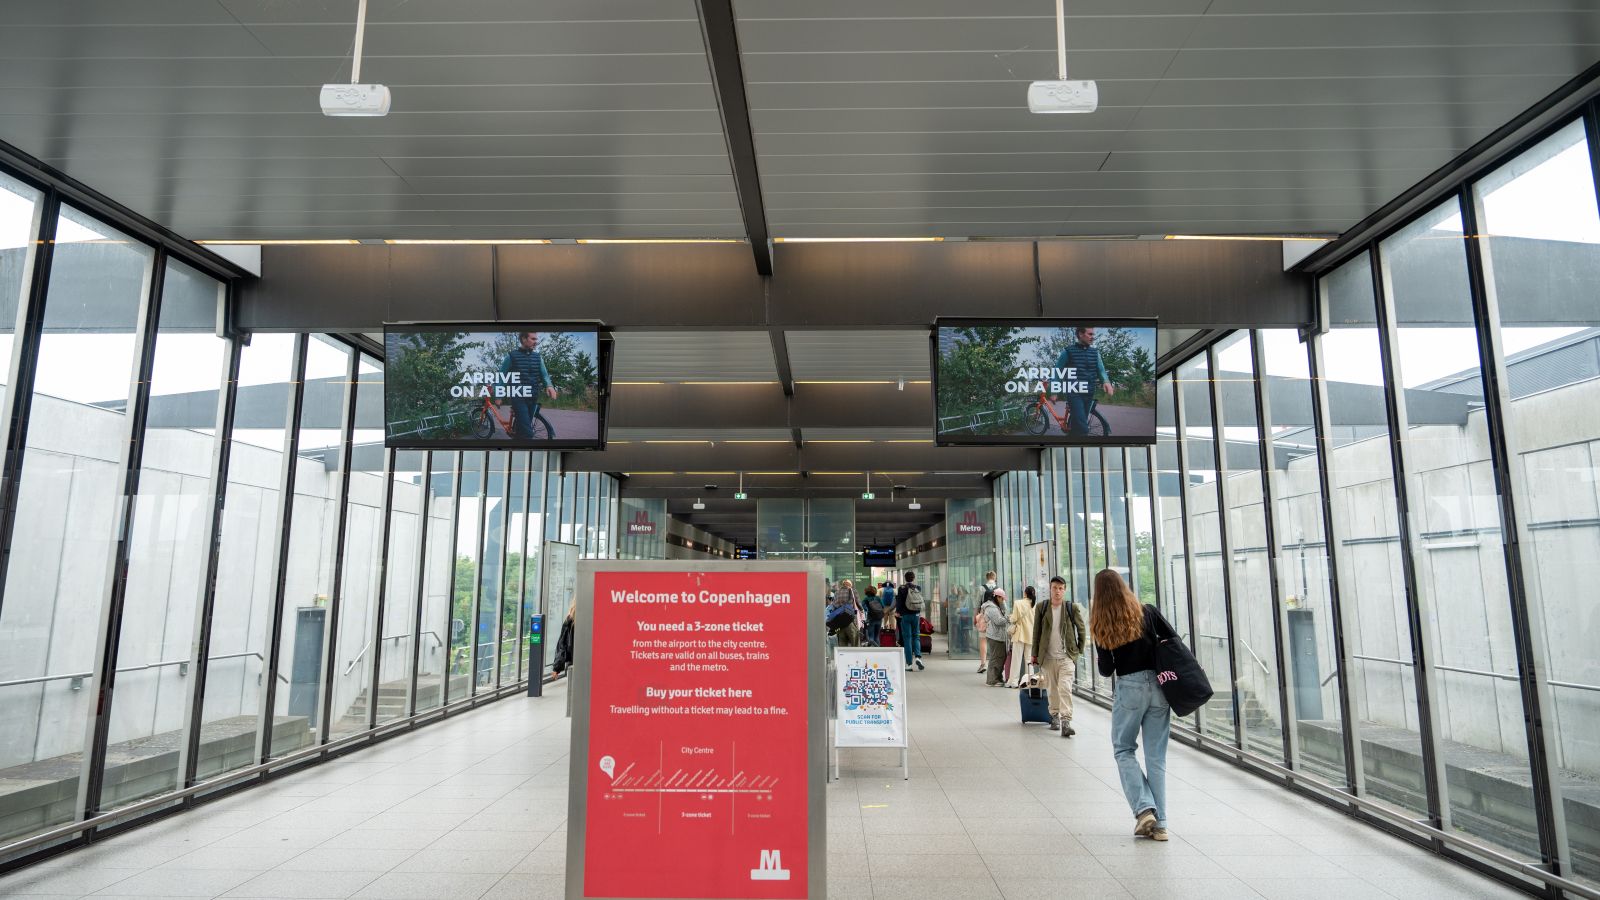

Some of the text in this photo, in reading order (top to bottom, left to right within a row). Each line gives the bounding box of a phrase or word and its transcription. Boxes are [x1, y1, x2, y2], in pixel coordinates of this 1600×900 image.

[461, 372, 521, 384] ARRIVE
[1016, 367, 1077, 379] ARRIVE
[450, 385, 532, 398] ON A BIKE
[1004, 381, 1089, 393] ON A BIKE
[960, 524, 982, 532] Metro
[610, 589, 791, 608] Welcome to Copenhagen
[636, 621, 764, 632] You need a 3-zone ticket
[632, 639, 768, 650] from the airport to the city centre.
[630, 650, 770, 661] Tickets are valid on all buses, trains
[669, 662, 729, 671] and the metro.
[646, 687, 753, 700] Buy your ticket here
[609, 704, 789, 717] Travelling without a ticket may lead to a fine.
[681, 746, 715, 755] City Centre
[760, 850, 782, 870] M
